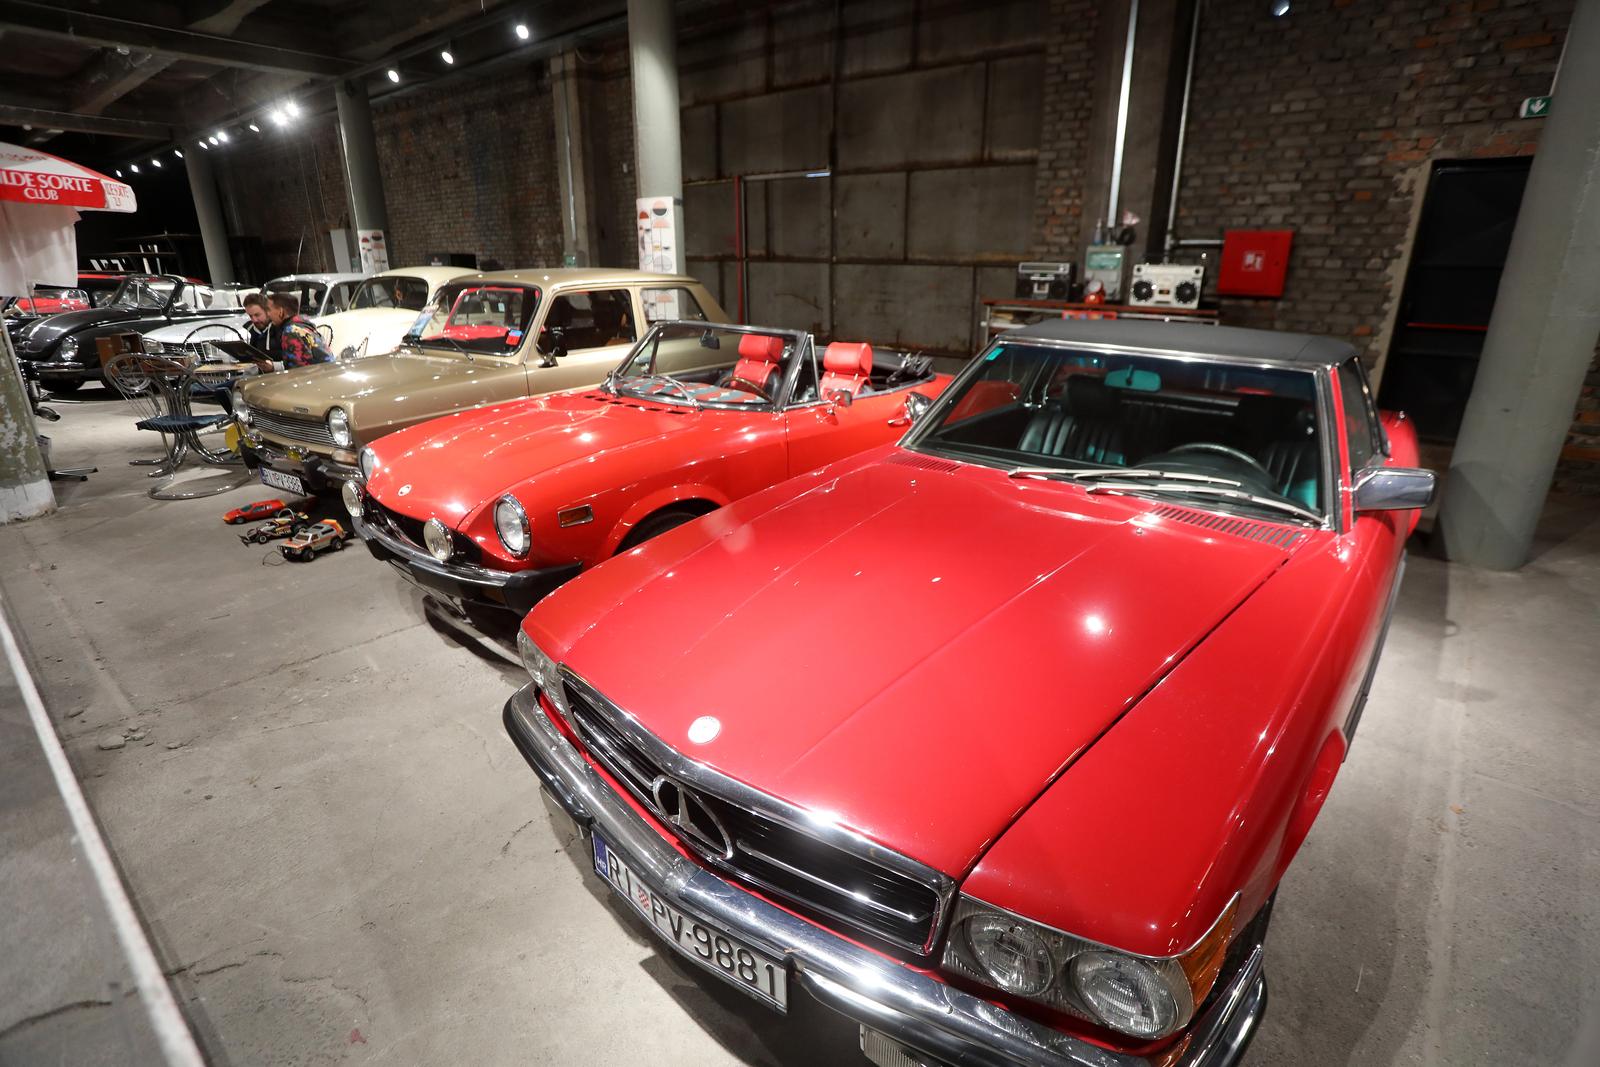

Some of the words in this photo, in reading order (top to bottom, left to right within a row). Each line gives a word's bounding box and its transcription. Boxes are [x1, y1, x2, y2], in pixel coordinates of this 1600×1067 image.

[37, 174, 93, 192] SORTE
[24, 187, 59, 200] CLUB
[608, 850, 632, 897] RI
[651, 892, 776, 997] PV-9881
